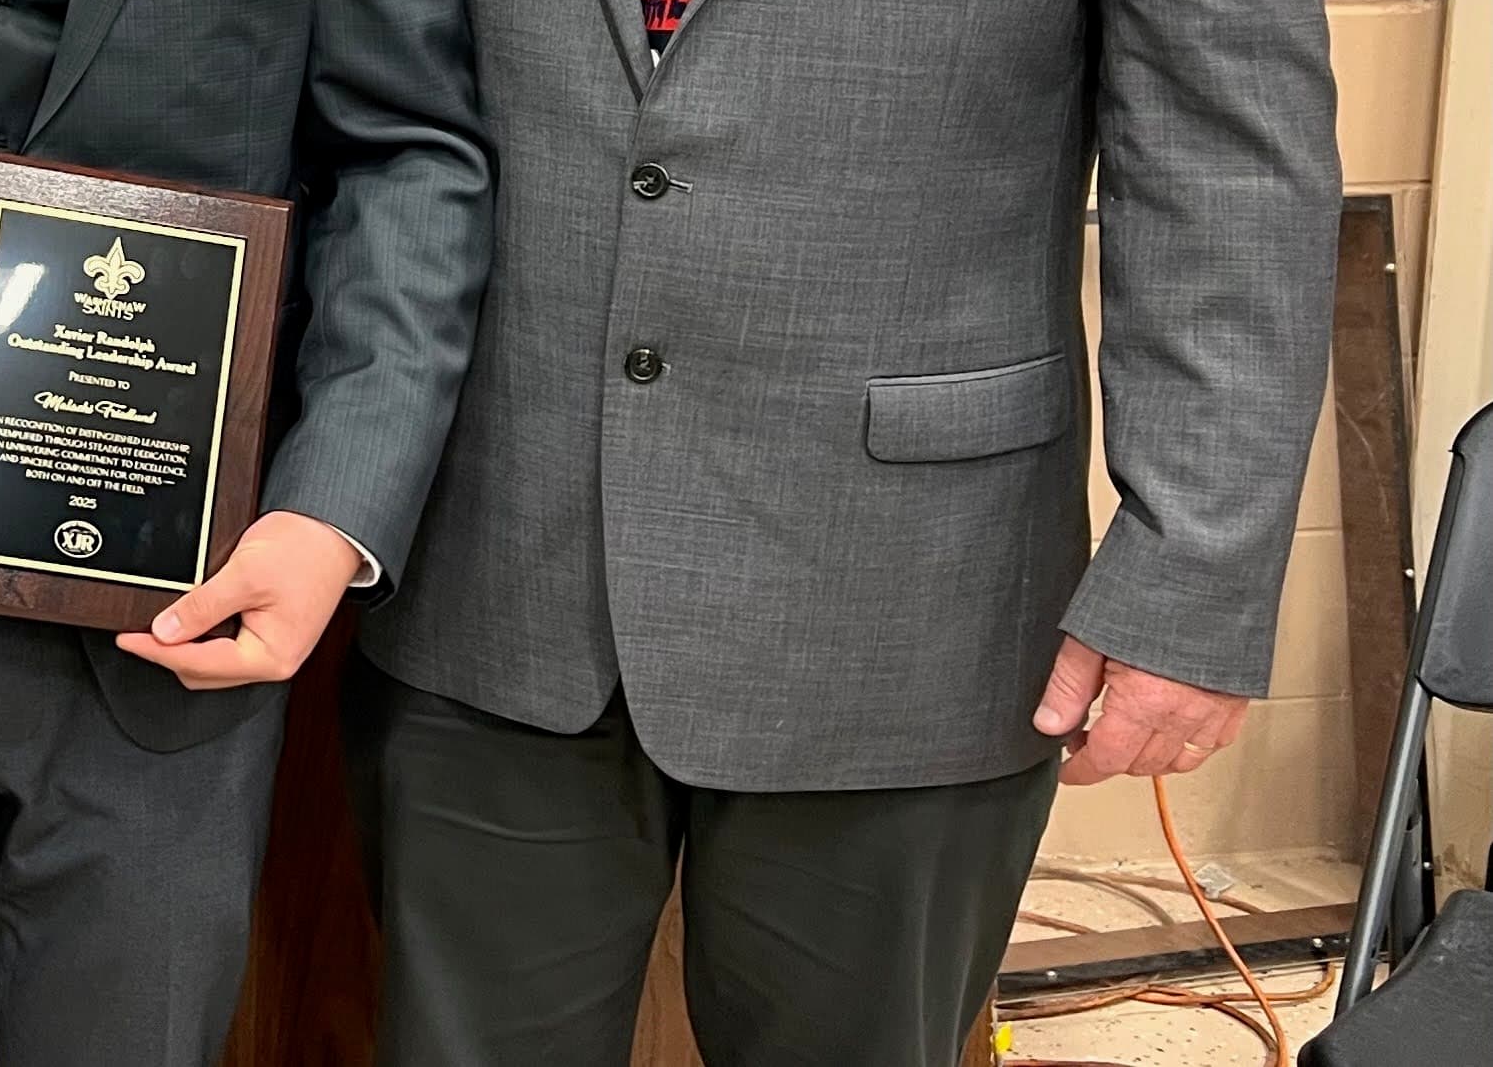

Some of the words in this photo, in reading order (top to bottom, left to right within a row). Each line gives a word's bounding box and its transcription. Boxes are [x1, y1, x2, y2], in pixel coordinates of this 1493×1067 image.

[82, 302, 134, 321] SAINTS
[54, 324, 94, 343] Xavier
[96, 330, 156, 353] Randolph
[7, 333, 85, 360] Outstanding
[86, 345, 153, 370] Leadership
[156, 356, 197, 375] Award
[5, 416, 65, 433] RECOGNITION
[66, 426, 78, 435] OF
[79, 428, 141, 445] DISTINGUISHED
[6, 441, 60, 457] UNWAVERING
[61, 450, 119, 466] COMMITMENT
[121, 459, 133, 469] TO
[45, 434, 87, 449] THROUGH
[88, 441, 132, 456] STEADFAST
[0, 453, 19, 463] AND
[19, 455, 53, 469] SINCERE
[54, 461, 110, 477] COMPASSION
[110, 469, 127, 480] FOR
[128, 473, 162, 485] OTHERS
[26, 469, 50, 480] BOTH
[51, 473, 65, 482] ON
[66, 476, 85, 486] AND
[86, 478, 102, 488] OFF
[104, 480, 120, 491] THE
[68, 495, 97, 509] 2025
[61, 531, 95, 552] XJR
